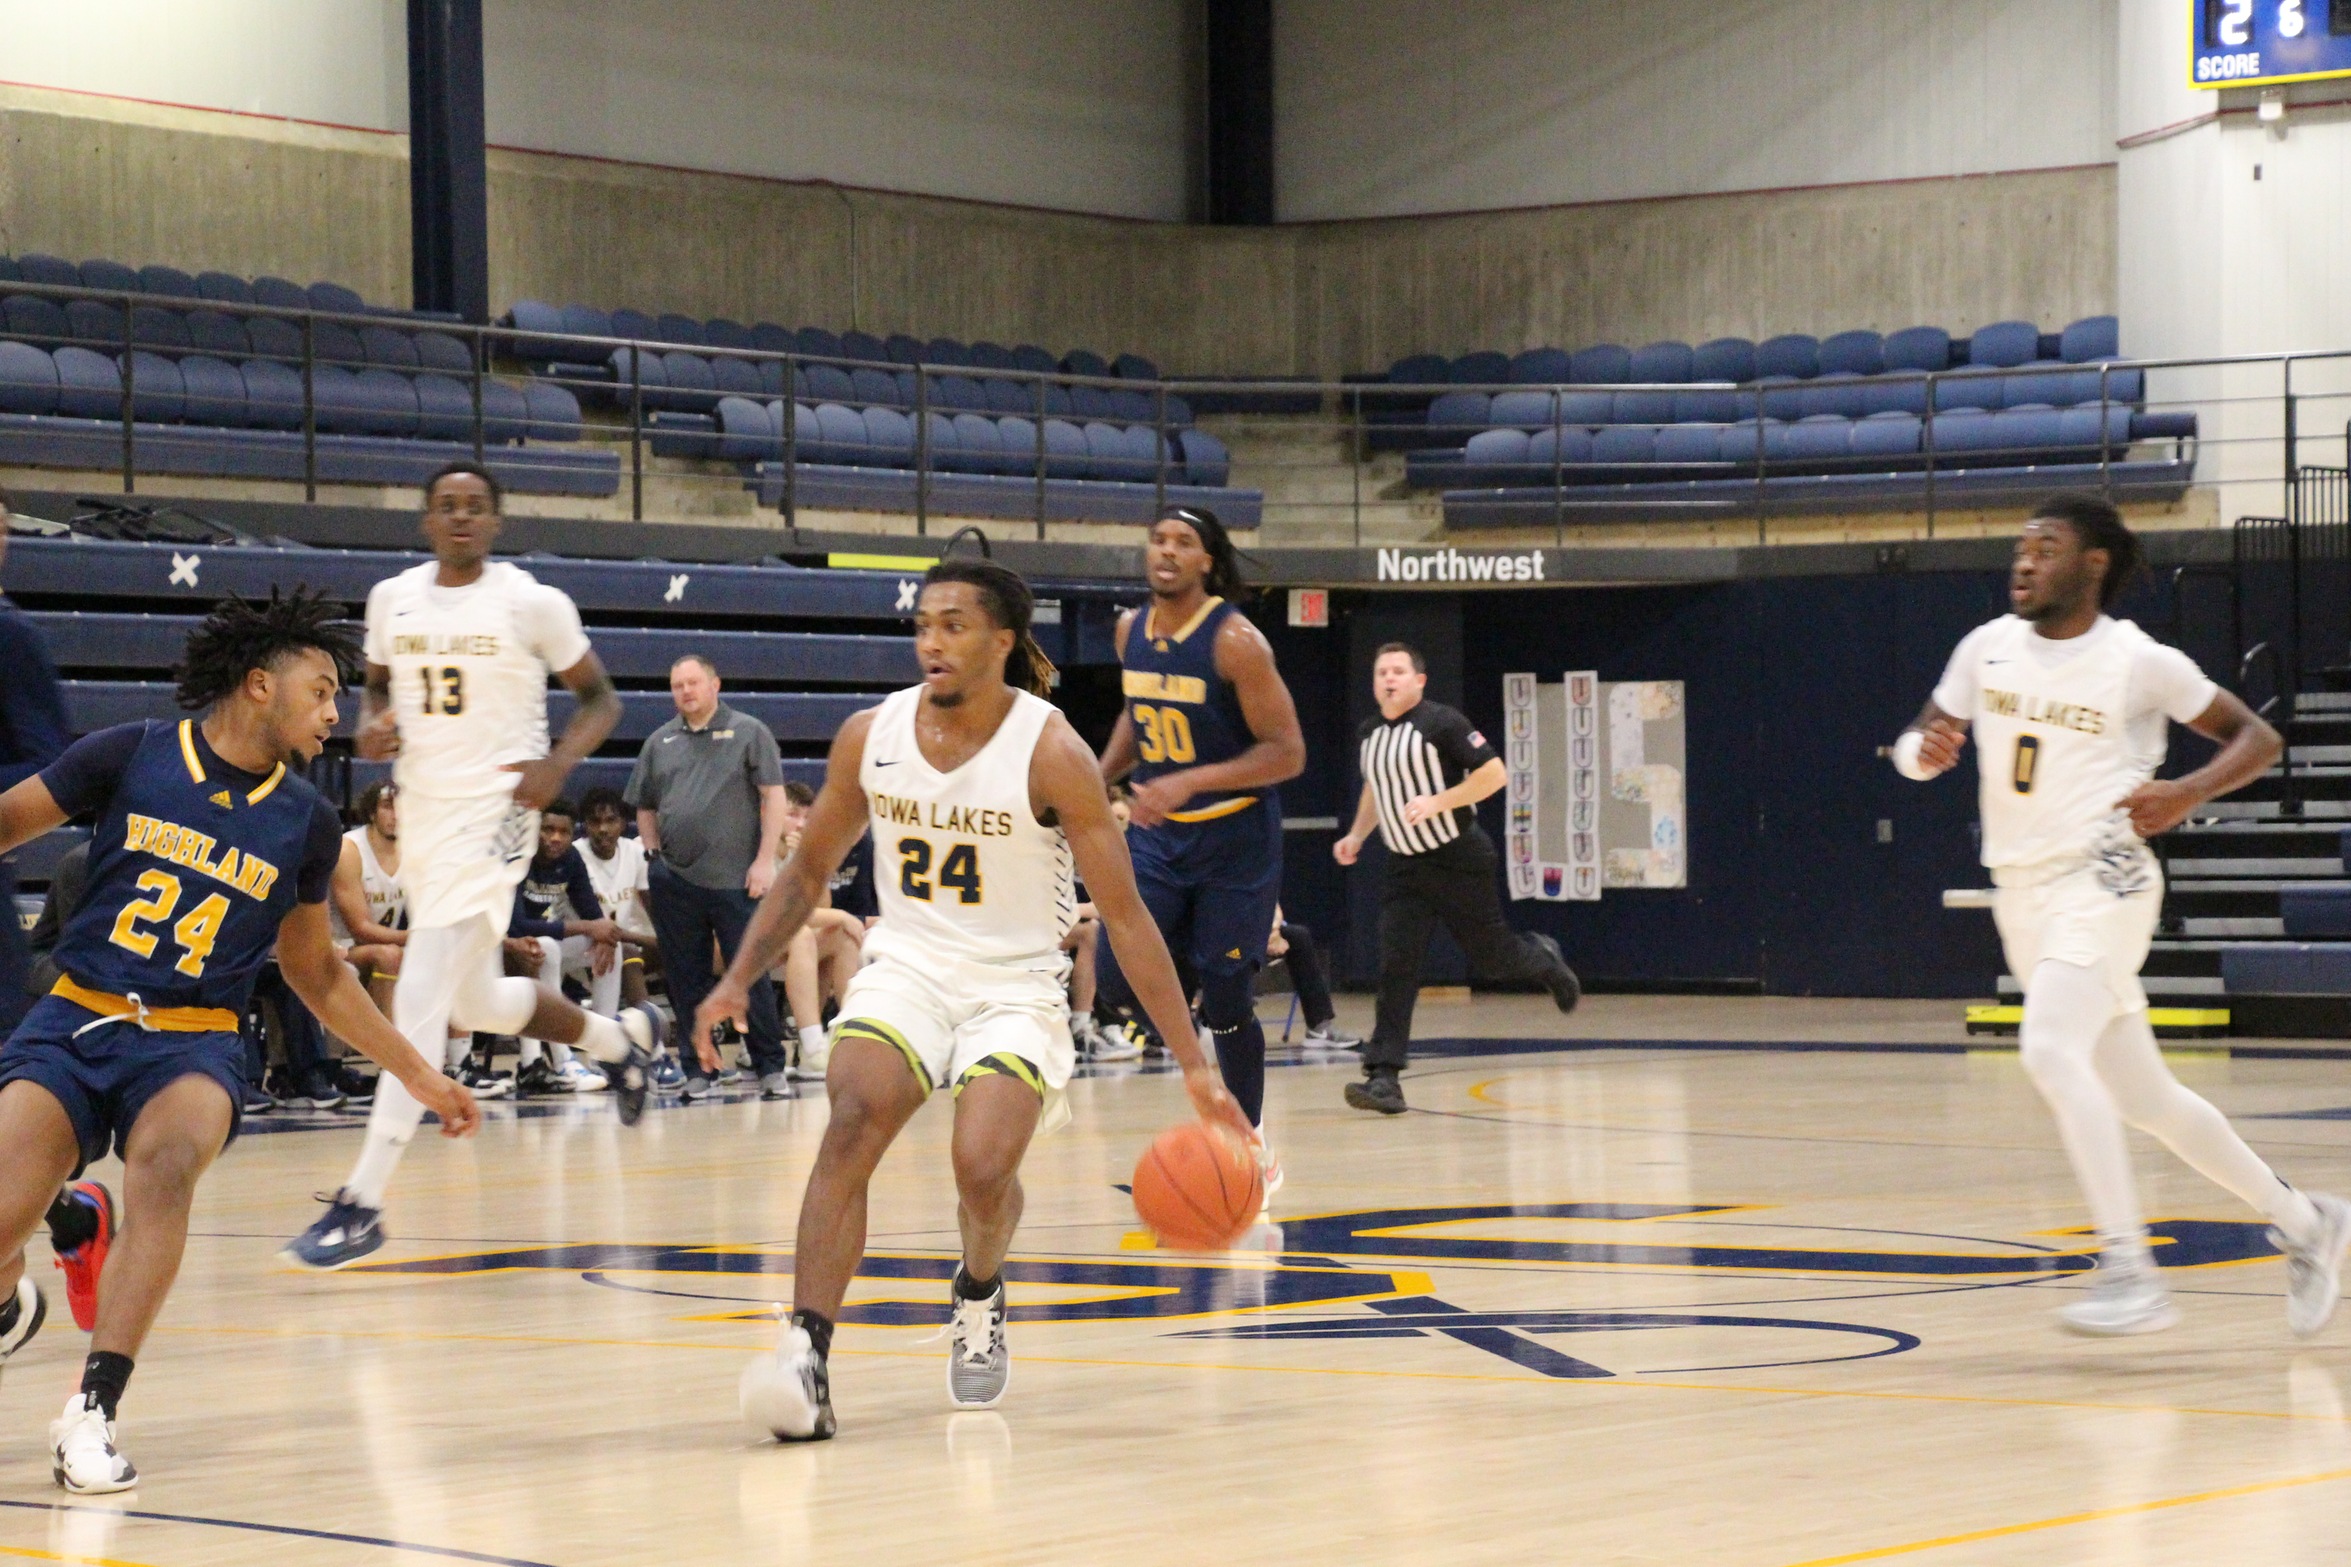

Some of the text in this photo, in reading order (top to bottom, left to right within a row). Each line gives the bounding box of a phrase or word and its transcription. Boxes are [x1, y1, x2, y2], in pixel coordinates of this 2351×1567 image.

[2198, 52, 2260, 80] SCORE
[1377, 548, 1545, 581] Northwest
[419, 664, 467, 717] 13
[1133, 703, 1197, 764] 30
[2014, 732, 2041, 796] 0
[931, 803, 1013, 836] LAKES
[123, 812, 279, 902] HIGHLAND
[896, 835, 983, 906] 24
[108, 868, 231, 979] 24
